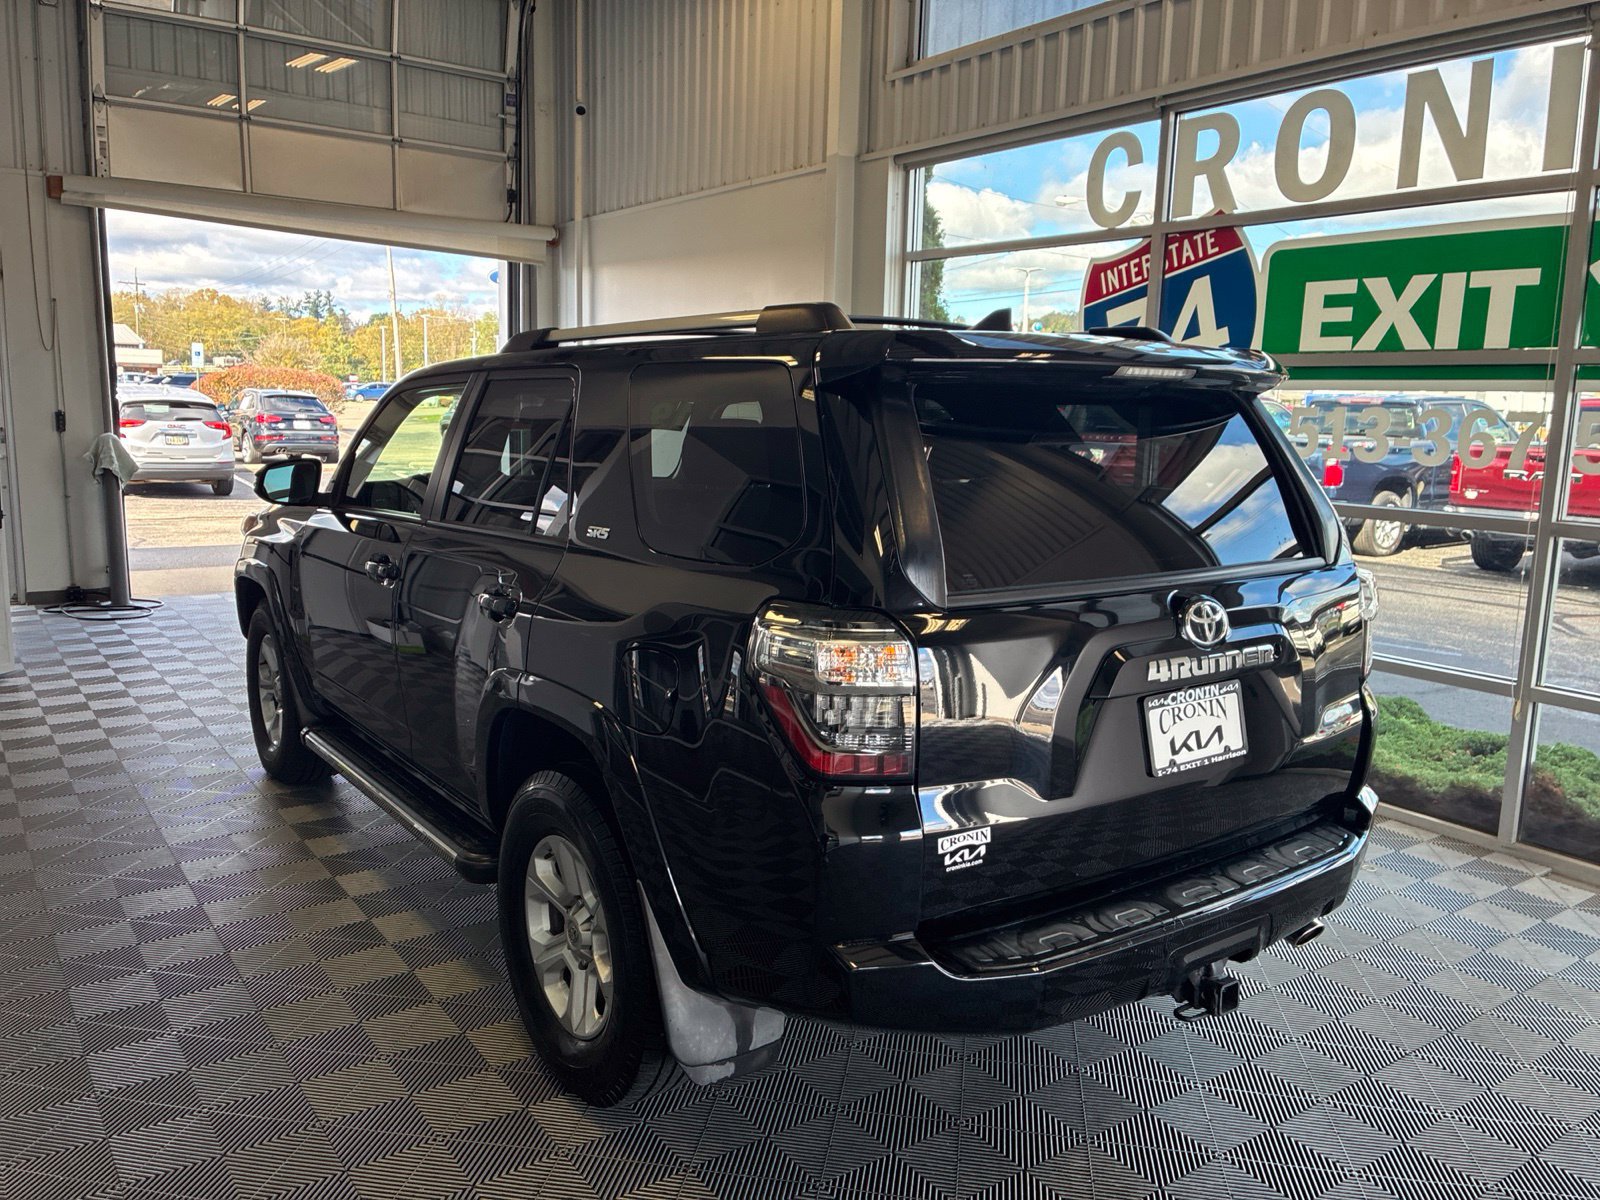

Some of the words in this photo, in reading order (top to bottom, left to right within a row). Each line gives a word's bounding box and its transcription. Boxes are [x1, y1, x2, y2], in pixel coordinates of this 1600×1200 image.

[1100, 229, 1219, 295] INTERTATE
[1299, 268, 1542, 352] EXIT
[586, 525, 611, 540] SR5
[1168, 684, 1219, 705] CRONIN
[1159, 697, 1228, 735] CRONIN
[1169, 724, 1224, 756] KIA
[1157, 766, 1178, 777] I-74
[1180, 761, 1202, 771] EXIT
[1211, 749, 1247, 763] Harrison
[940, 829, 989, 851] CRONIN
[944, 844, 987, 866] KIA
[945, 859, 983, 873] croninkia.com
